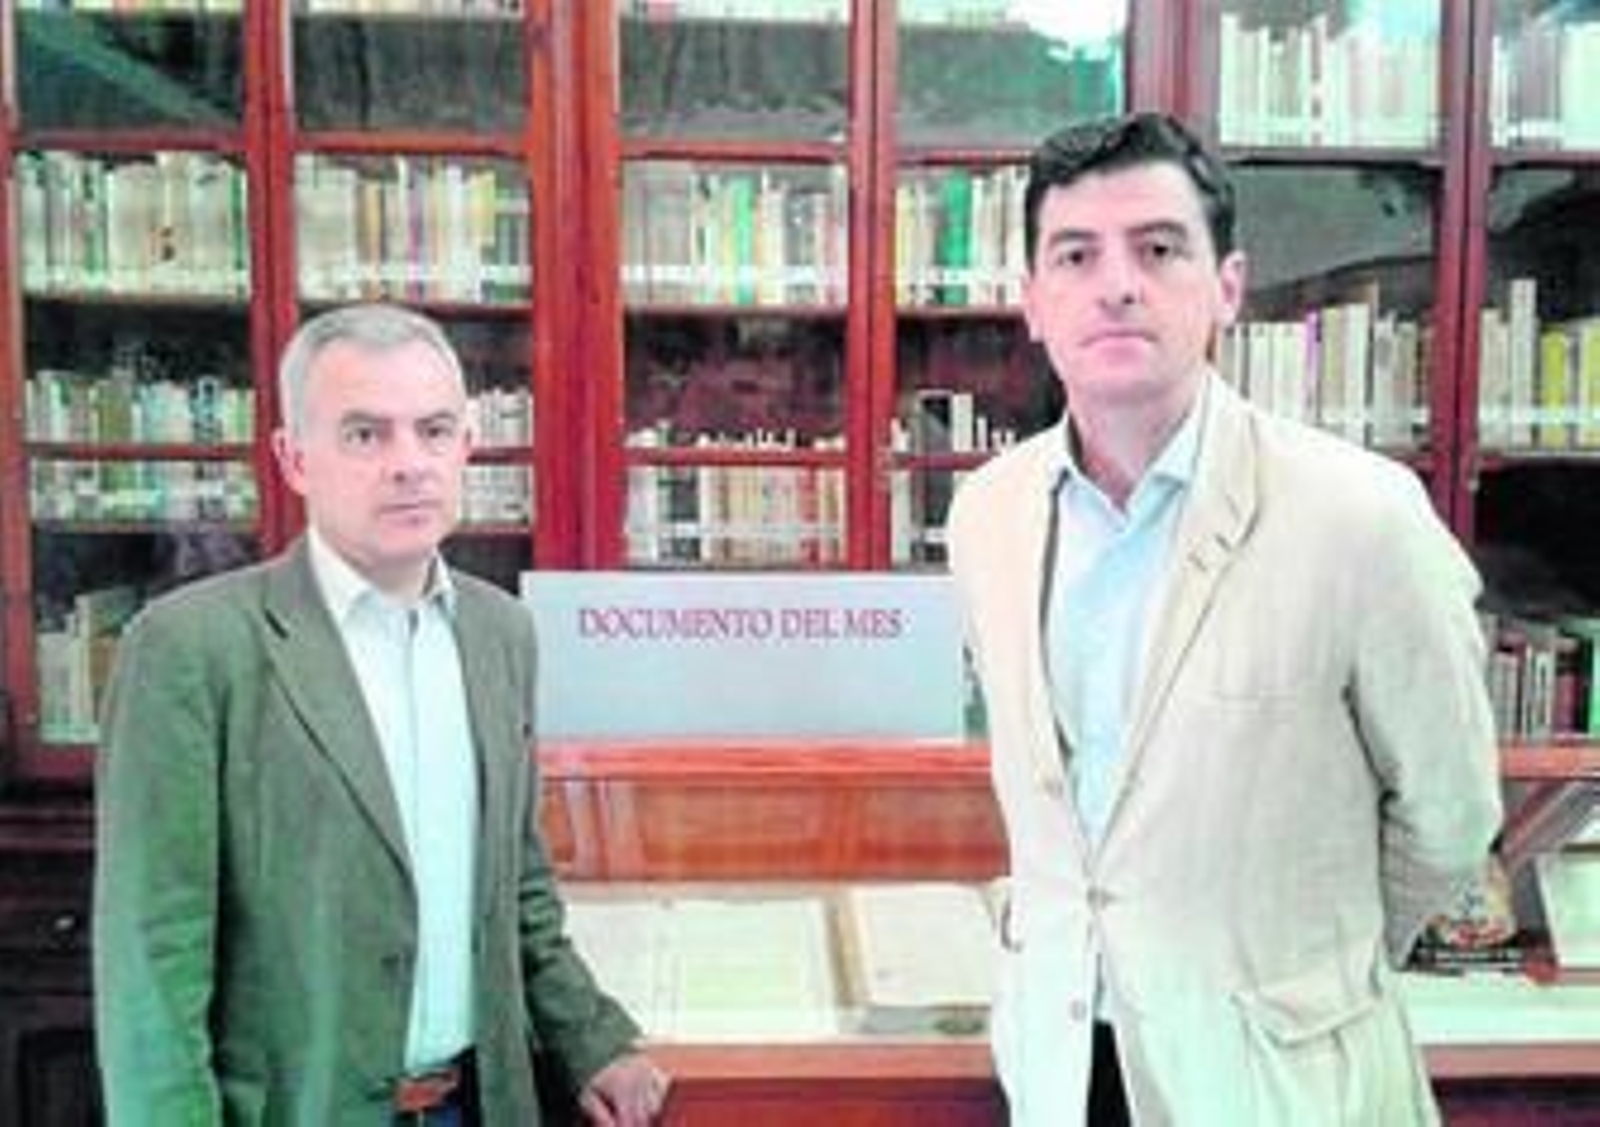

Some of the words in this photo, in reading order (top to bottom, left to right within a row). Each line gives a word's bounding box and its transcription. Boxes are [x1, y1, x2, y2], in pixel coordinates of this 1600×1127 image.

[578, 608, 773, 641] DOCUMENTO
[780, 608, 839, 640] DEL
[844, 608, 904, 640] MES
